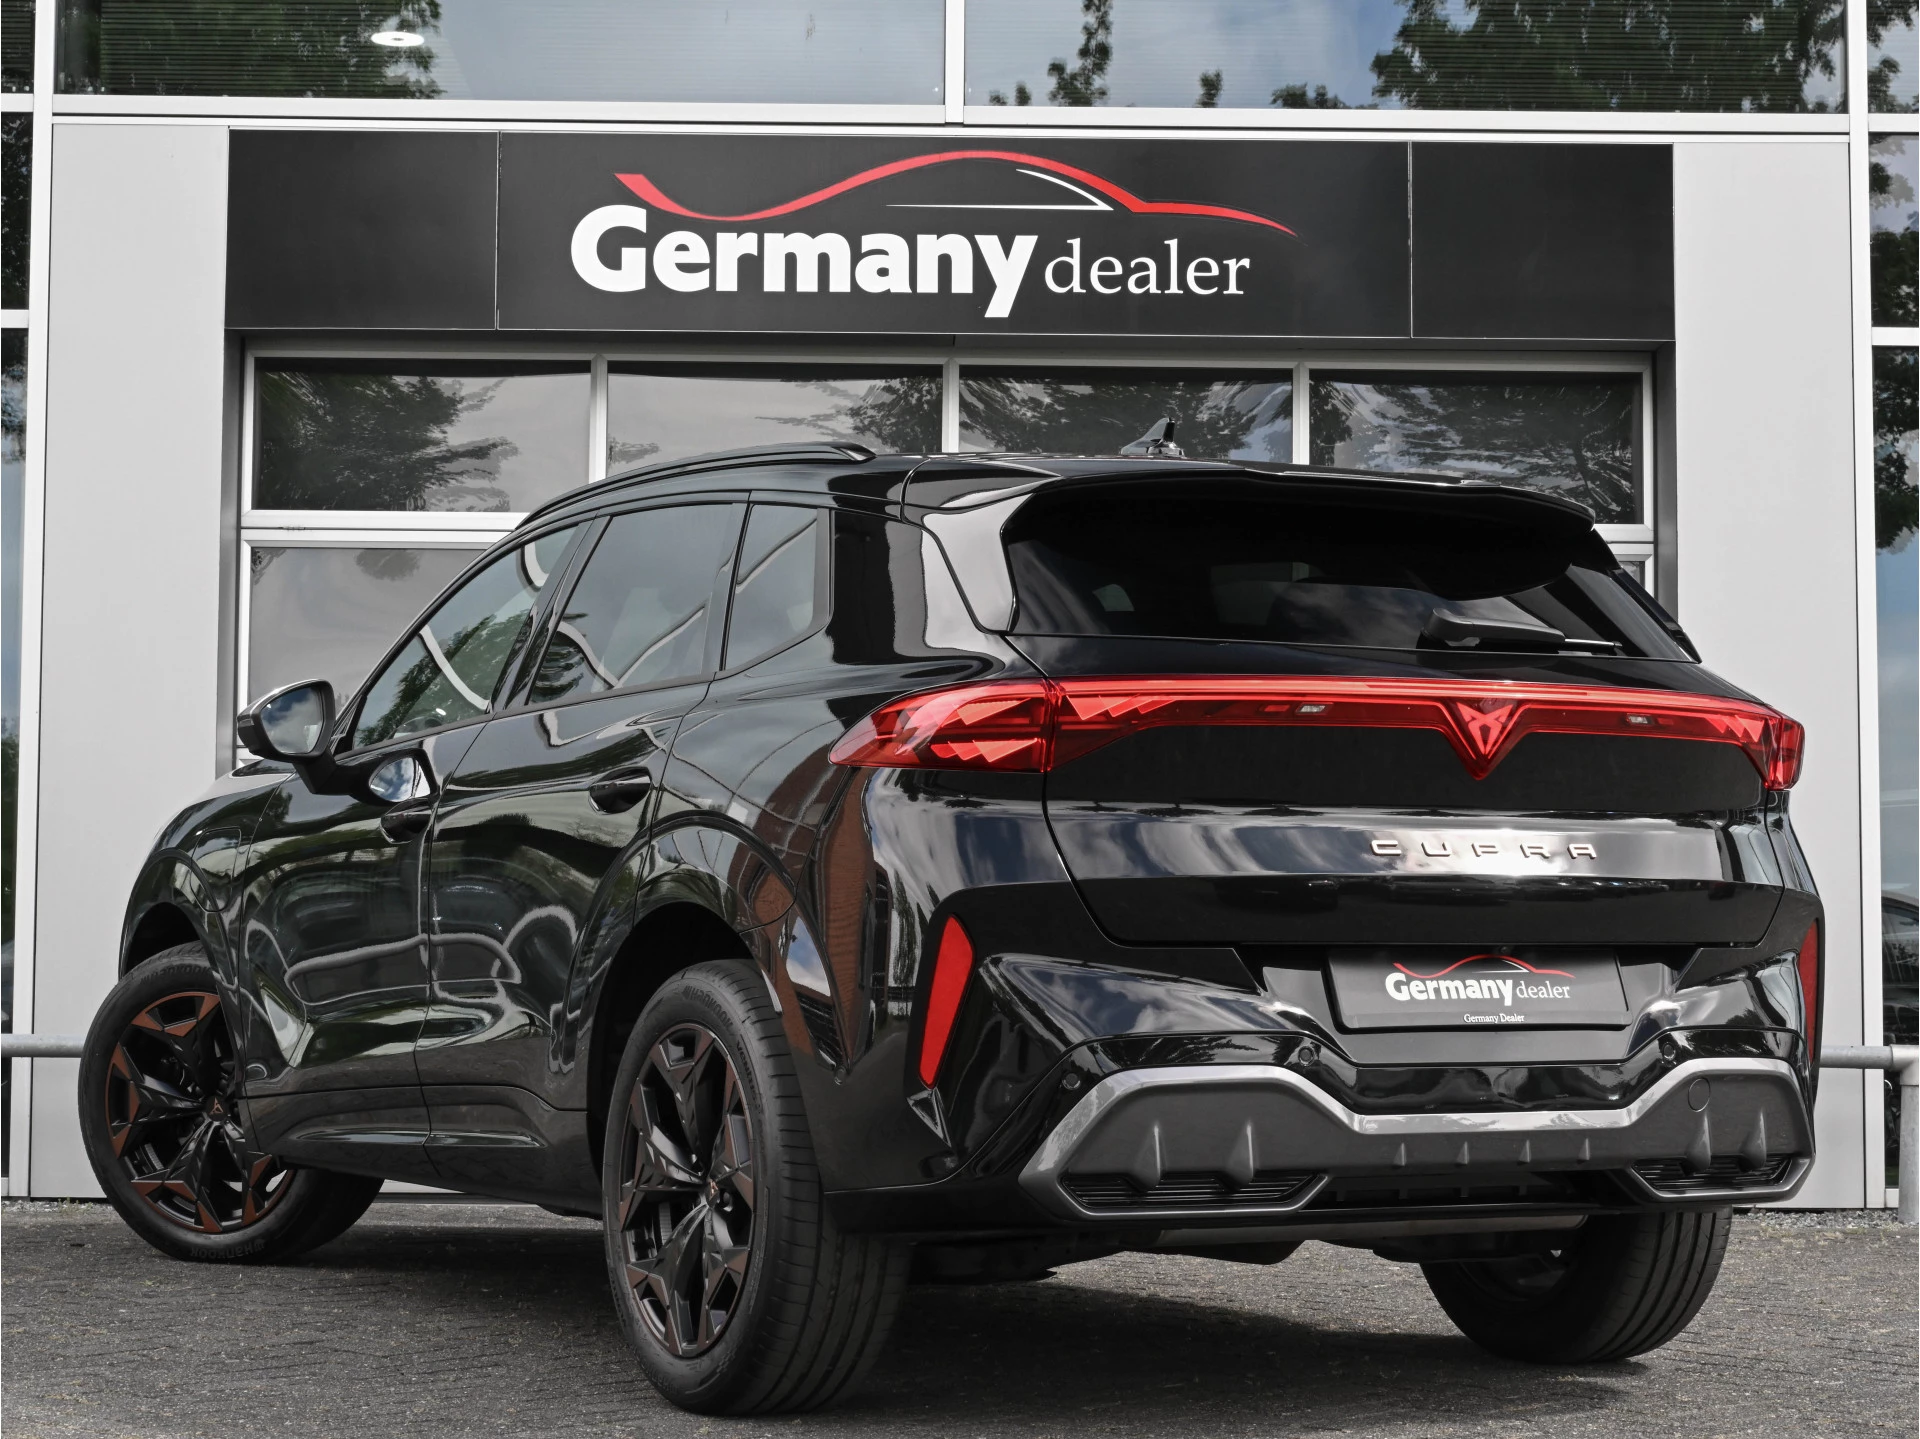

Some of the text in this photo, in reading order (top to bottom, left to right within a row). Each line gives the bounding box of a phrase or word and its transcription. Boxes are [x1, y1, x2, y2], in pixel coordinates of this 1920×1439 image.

[570, 204, 1251, 318] Germany dealer
[1370, 839, 1597, 860] CUPRA
[1385, 972, 1570, 1006] Germany dealer
[1463, 1013, 1525, 1024] Germany Dealer
